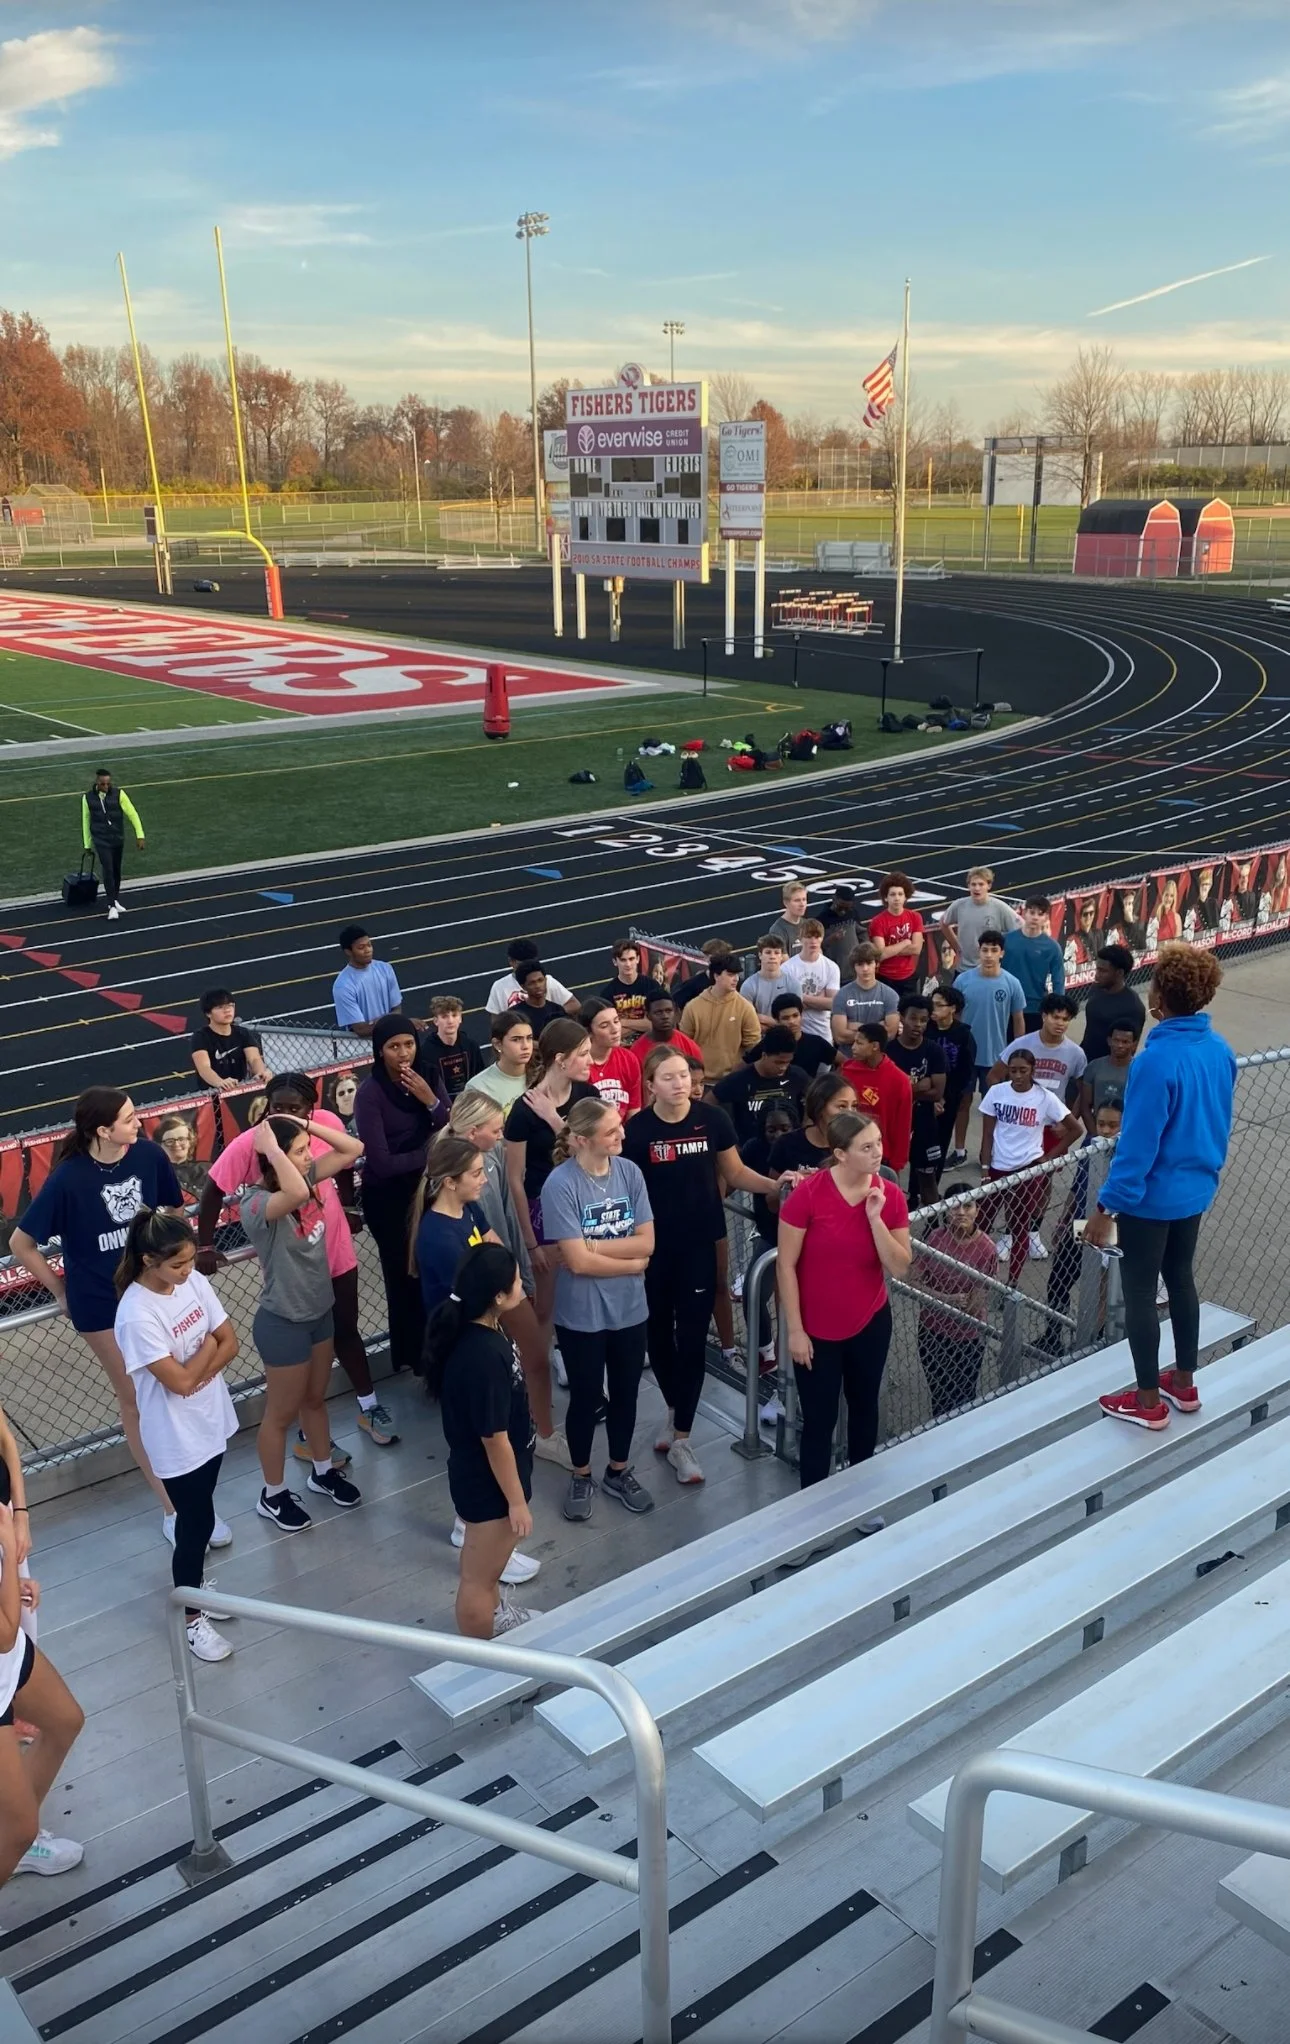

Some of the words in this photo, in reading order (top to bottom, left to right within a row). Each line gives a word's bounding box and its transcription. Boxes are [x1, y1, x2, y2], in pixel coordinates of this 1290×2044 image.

[571, 393, 633, 416] FISHERS
[638, 389, 696, 414] TIGERS
[597, 426, 662, 448] everwise
[666, 429, 689, 438] CREDIT
[721, 426, 732, 437] Go
[734, 424, 764, 439] Tigers!
[666, 438, 689, 447] UNION
[737, 449, 760, 462] OMI
[574, 458, 597, 474] HOME
[666, 456, 700, 473] GUESTS
[726, 484, 735, 492] GO
[736, 484, 759, 492] TIGERS!
[666, 502, 700, 519] QUARTER
[573, 553, 590, 564] 2010
[603, 555, 624, 566] STATE
[626, 556, 665, 569] FOOTBALL
[667, 558, 700, 570] CHAMPS
[552, 825, 615, 838] 1
[594, 833, 663, 849] 2
[645, 842, 710, 858] 3
[696, 855, 767, 872] 4
[750, 864, 828, 882] 5
[1065, 970, 1096, 987] LENNO
[0, 1143, 17, 1151] AND
[24, 1136, 50, 1147] FISHERS
[675, 1140, 709, 1155] TAMPA
[601, 1209, 621, 1221] STATE
[98, 1226, 130, 1252] ONW
[171, 1305, 205, 1339] FISHERS
